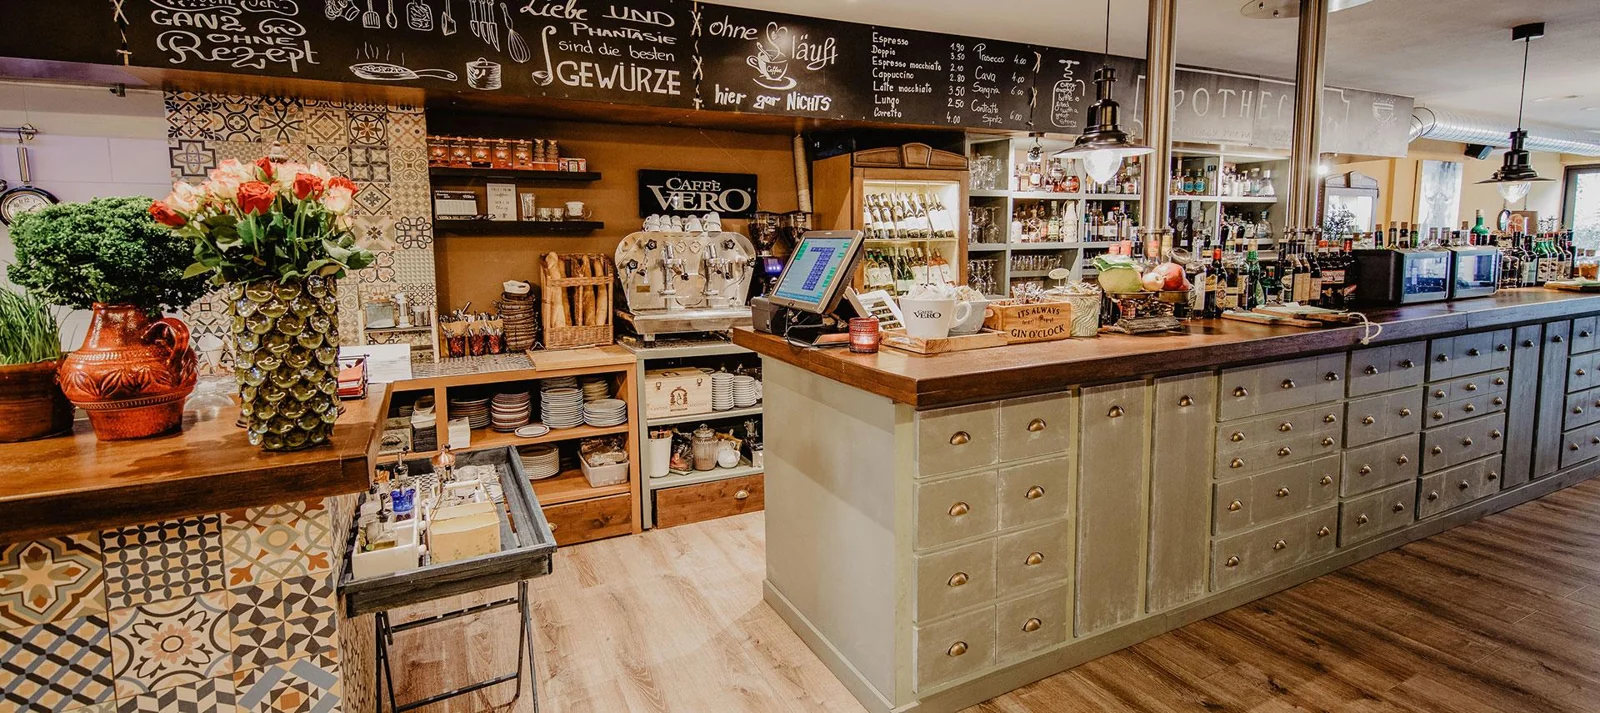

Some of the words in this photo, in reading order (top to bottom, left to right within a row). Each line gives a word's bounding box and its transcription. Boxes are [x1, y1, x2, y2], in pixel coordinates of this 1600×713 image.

[151, 10, 246, 32] GANZ
[520, 0, 588, 20] Liebe
[602, 5, 675, 27] UND
[206, 34, 298, 46] OHNE
[709, 15, 758, 40] ohne
[792, 34, 838, 70] läuft
[872, 32, 909, 47] Espresso
[156, 30, 320, 72] Rezept
[558, 40, 593, 54] sind
[598, 43, 622, 57] die
[629, 45, 675, 62] besten
[871, 45, 896, 58] Doppio
[973, 43, 1005, 63] Prosecco
[872, 56, 906, 69] Espresso
[910, 60, 941, 71] macchiato
[556, 60, 680, 95] GEWÜRZE
[872, 67, 914, 81] Cappuccino
[975, 66, 996, 82] Cava
[873, 81, 894, 92] Latte
[899, 83, 932, 93] macchiato
[972, 82, 1000, 99] Sangria
[715, 84, 746, 105] hier
[753, 94, 780, 109] gar
[874, 94, 899, 109] Lungo
[874, 107, 902, 118] Corretto
[971, 99, 999, 114] Contratto
[982, 114, 1002, 126] Spritz
[666, 178, 721, 191] CAFFÈ
[646, 185, 751, 212] VERO
[1018, 309, 1030, 318] ITS
[1032, 307, 1060, 315] ALWAYS
[1011, 328, 1027, 338] GIN
[1029, 324, 1065, 338] O'CLOCK
